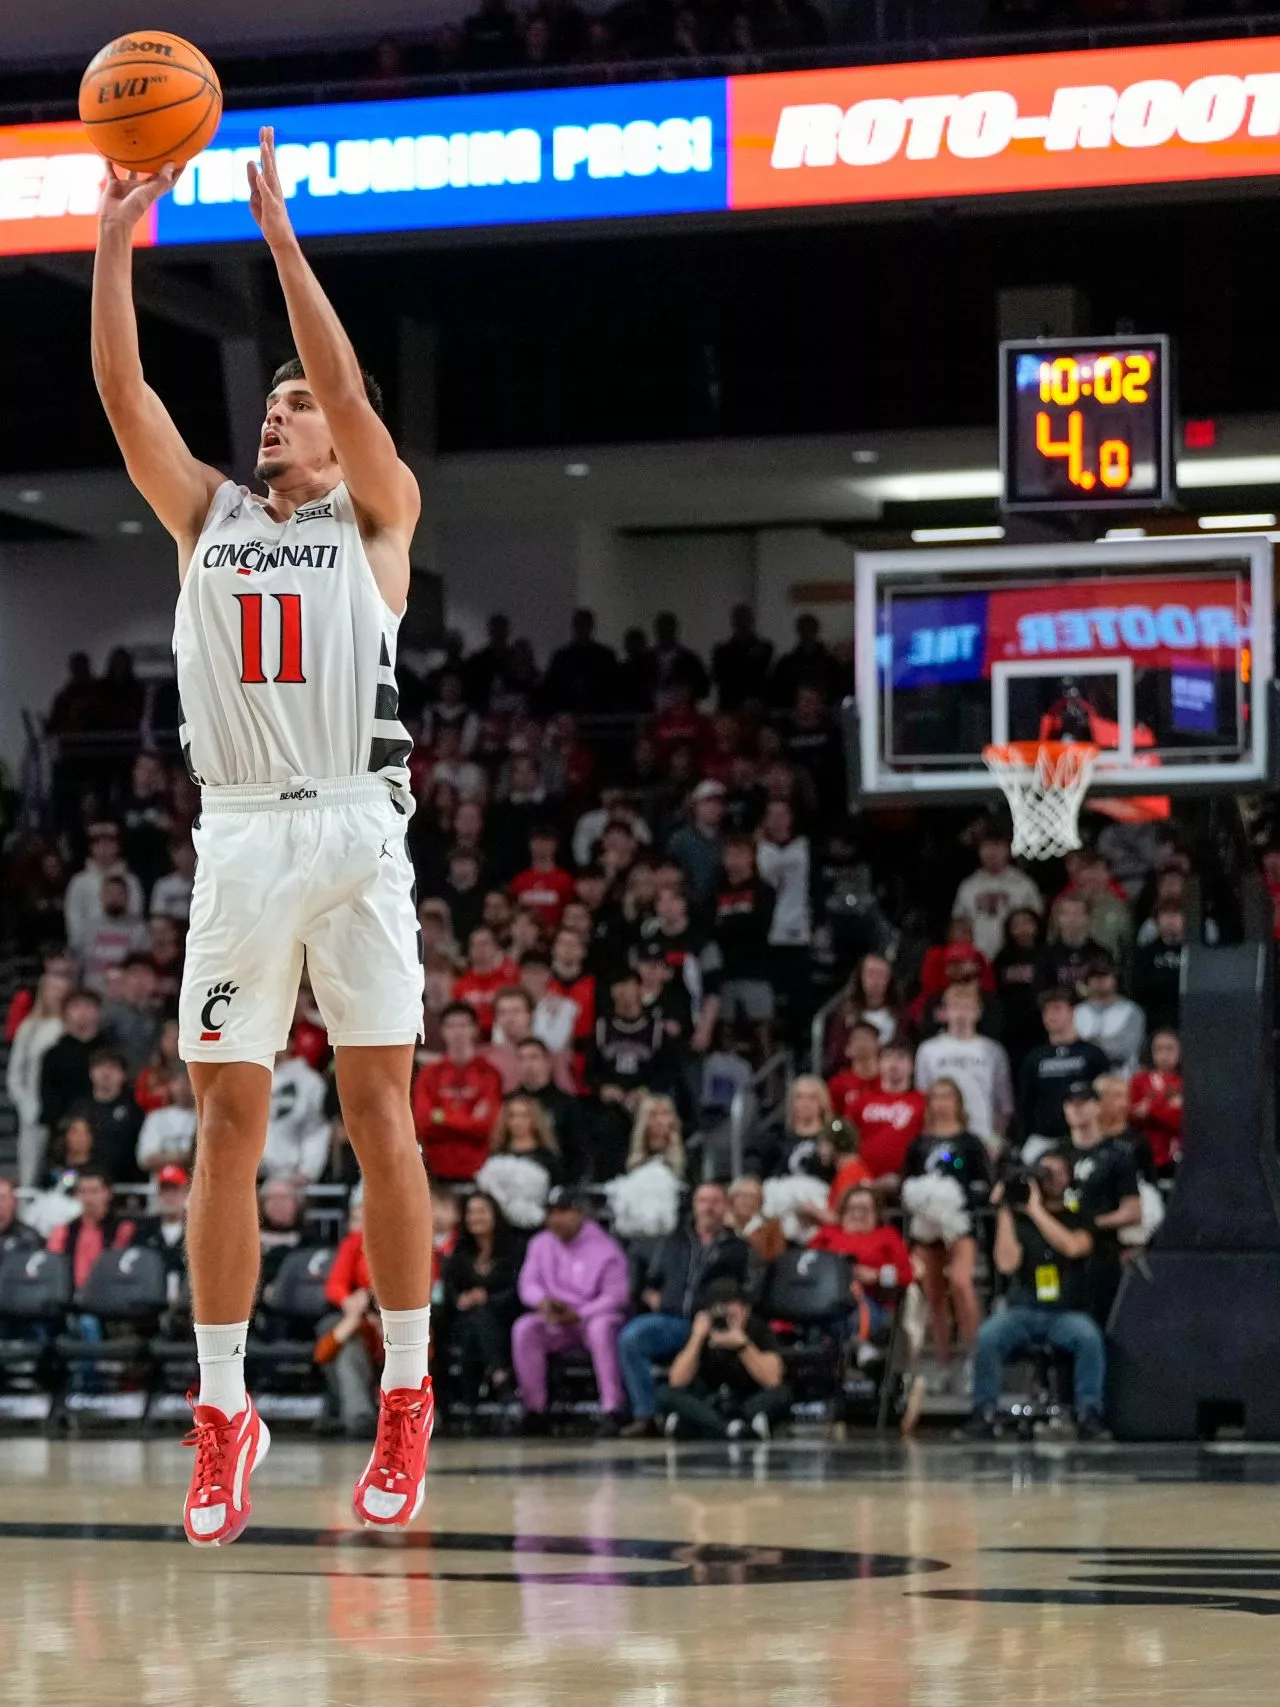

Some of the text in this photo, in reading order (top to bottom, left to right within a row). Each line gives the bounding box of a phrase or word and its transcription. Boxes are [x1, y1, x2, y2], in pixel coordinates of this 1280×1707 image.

[1039, 355, 1152, 406] 10:02
[203, 540, 338, 574] CINCINNATI
[232, 592, 307, 684] 11
[279, 787, 318, 801] BEARCATS
